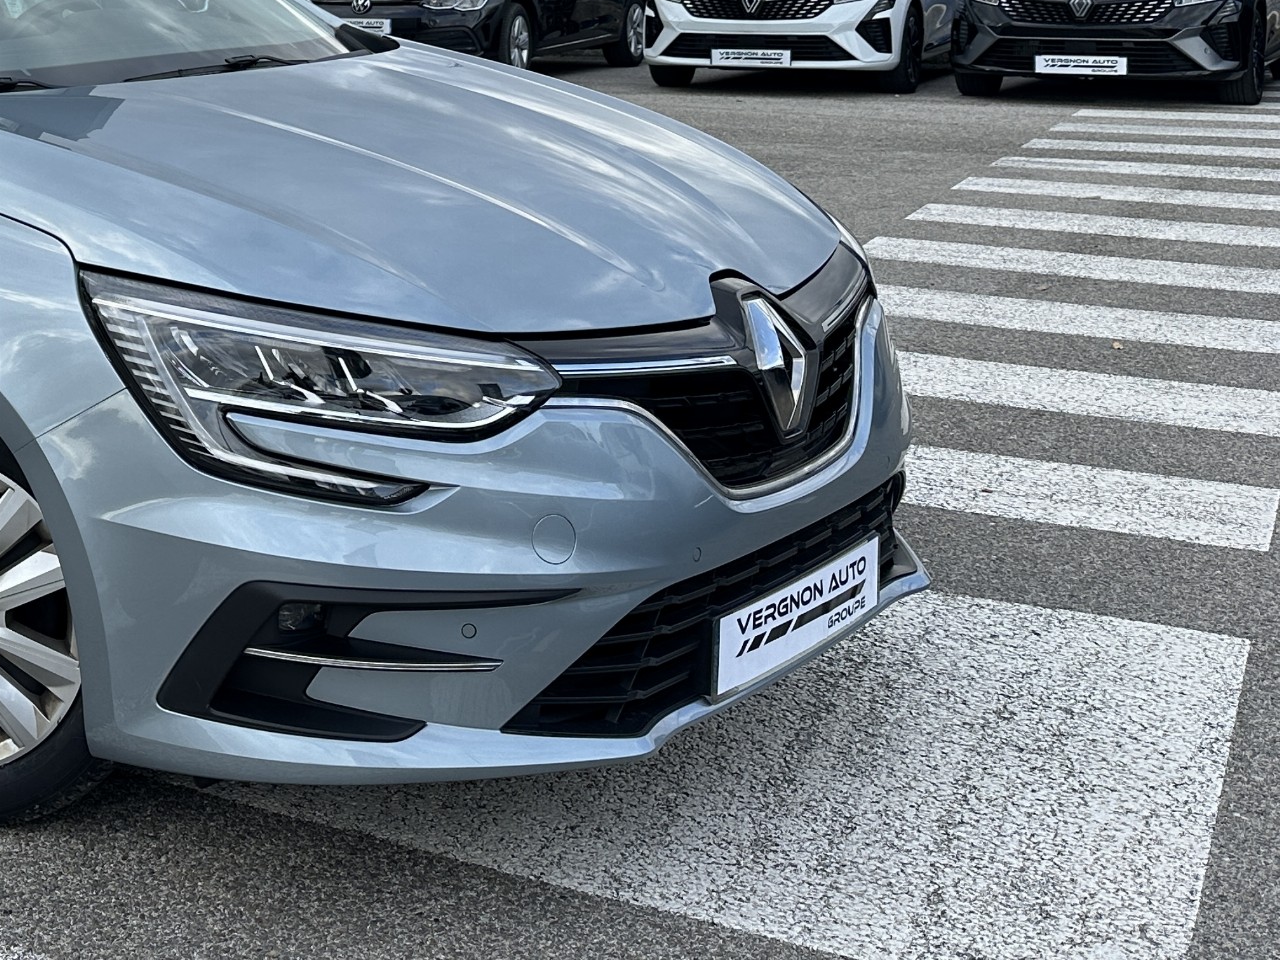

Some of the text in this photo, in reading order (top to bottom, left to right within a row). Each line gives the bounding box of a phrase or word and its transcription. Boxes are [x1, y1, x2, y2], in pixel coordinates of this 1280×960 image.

[736, 555, 867, 635] VERGNON AUTO
[827, 595, 866, 629] GROUPE
